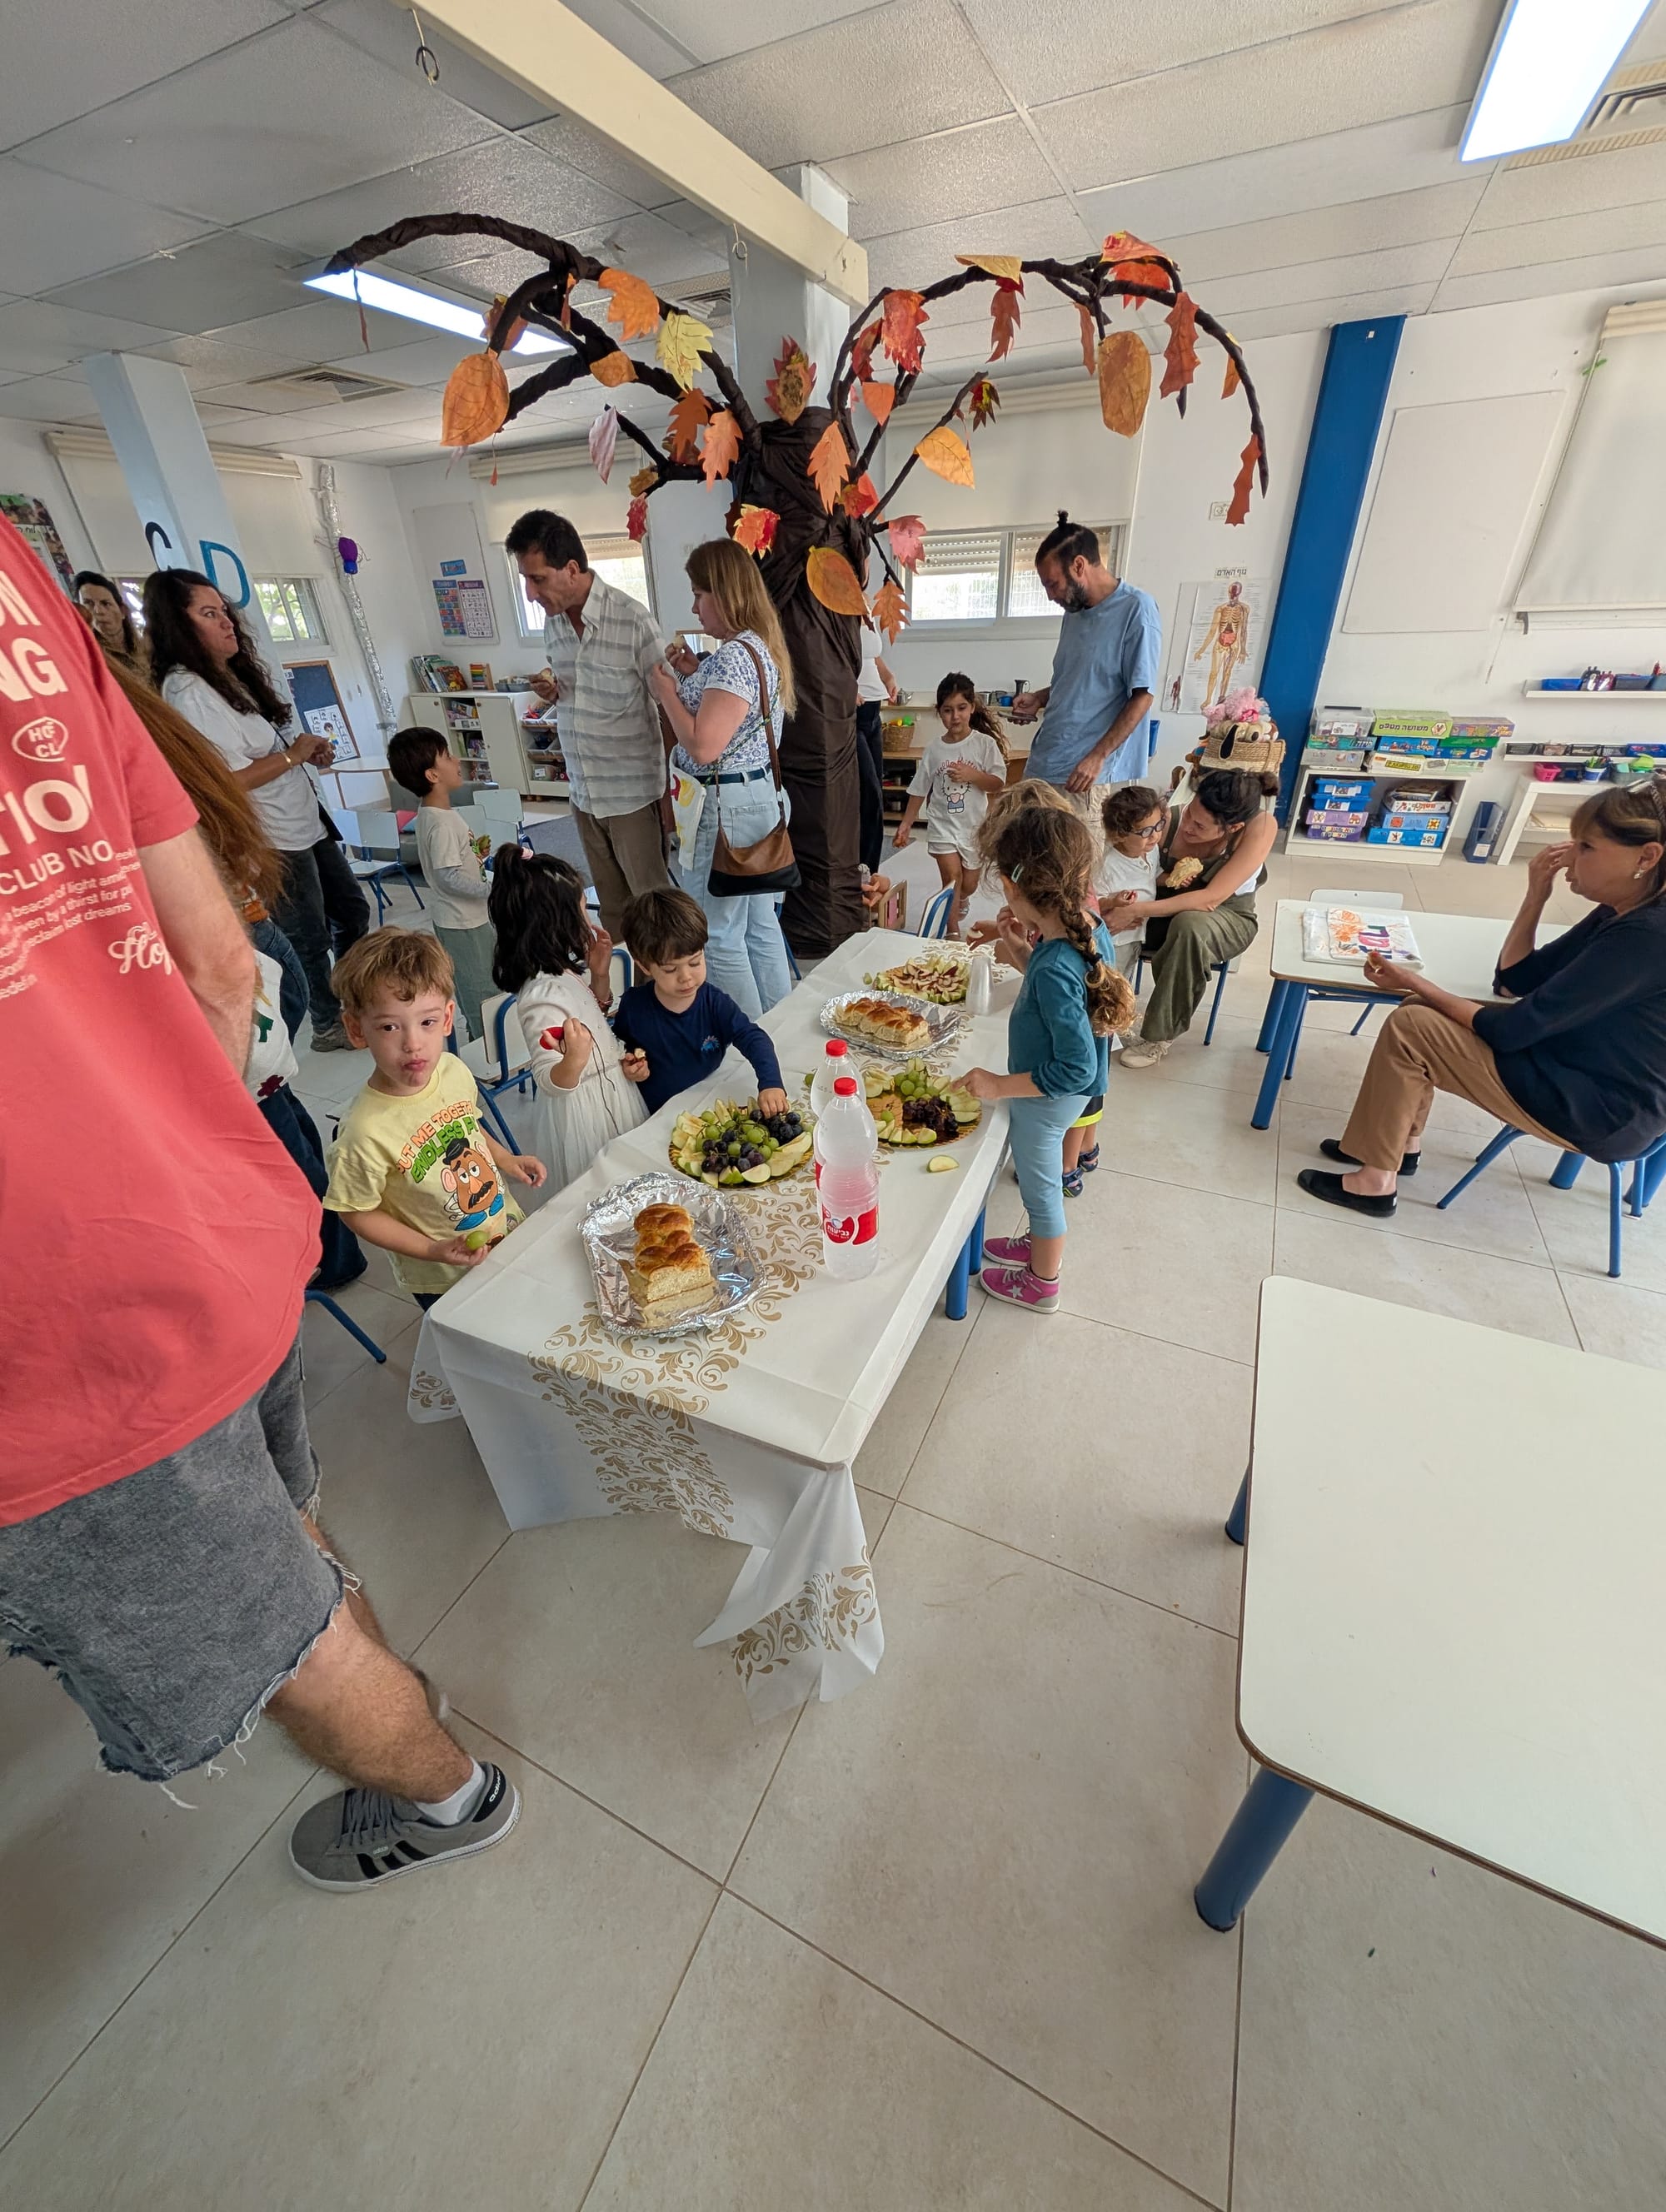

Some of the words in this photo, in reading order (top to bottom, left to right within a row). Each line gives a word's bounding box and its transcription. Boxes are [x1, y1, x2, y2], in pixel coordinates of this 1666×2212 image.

[199, 540, 250, 610] D
[0, 852, 65, 894] CLUB
[84, 902, 132, 920] dreams
[410, 1121, 437, 1148] ME
[411, 1120, 466, 1183] ENDLESS
